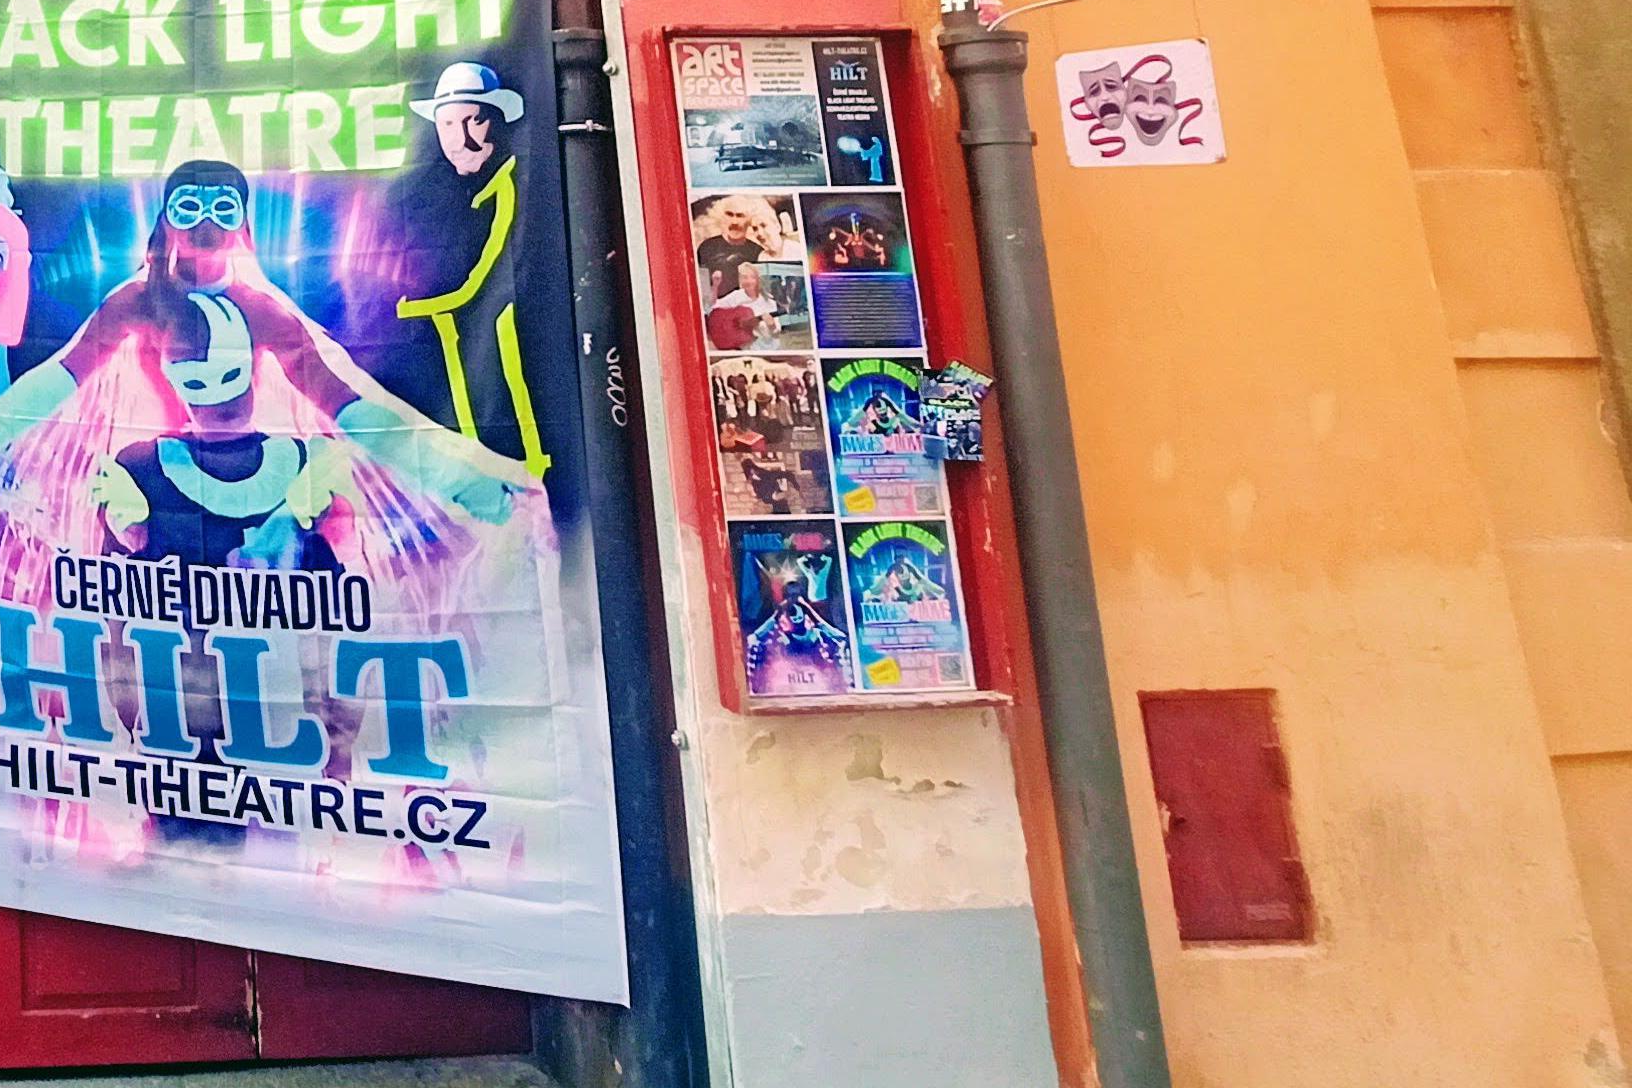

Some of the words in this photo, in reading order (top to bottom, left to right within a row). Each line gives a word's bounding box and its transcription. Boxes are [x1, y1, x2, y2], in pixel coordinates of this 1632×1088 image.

[829, 66, 869, 81] HILT
[53, 548, 179, 621] ČERNÉ
[194, 570, 371, 632] DIVADLO
